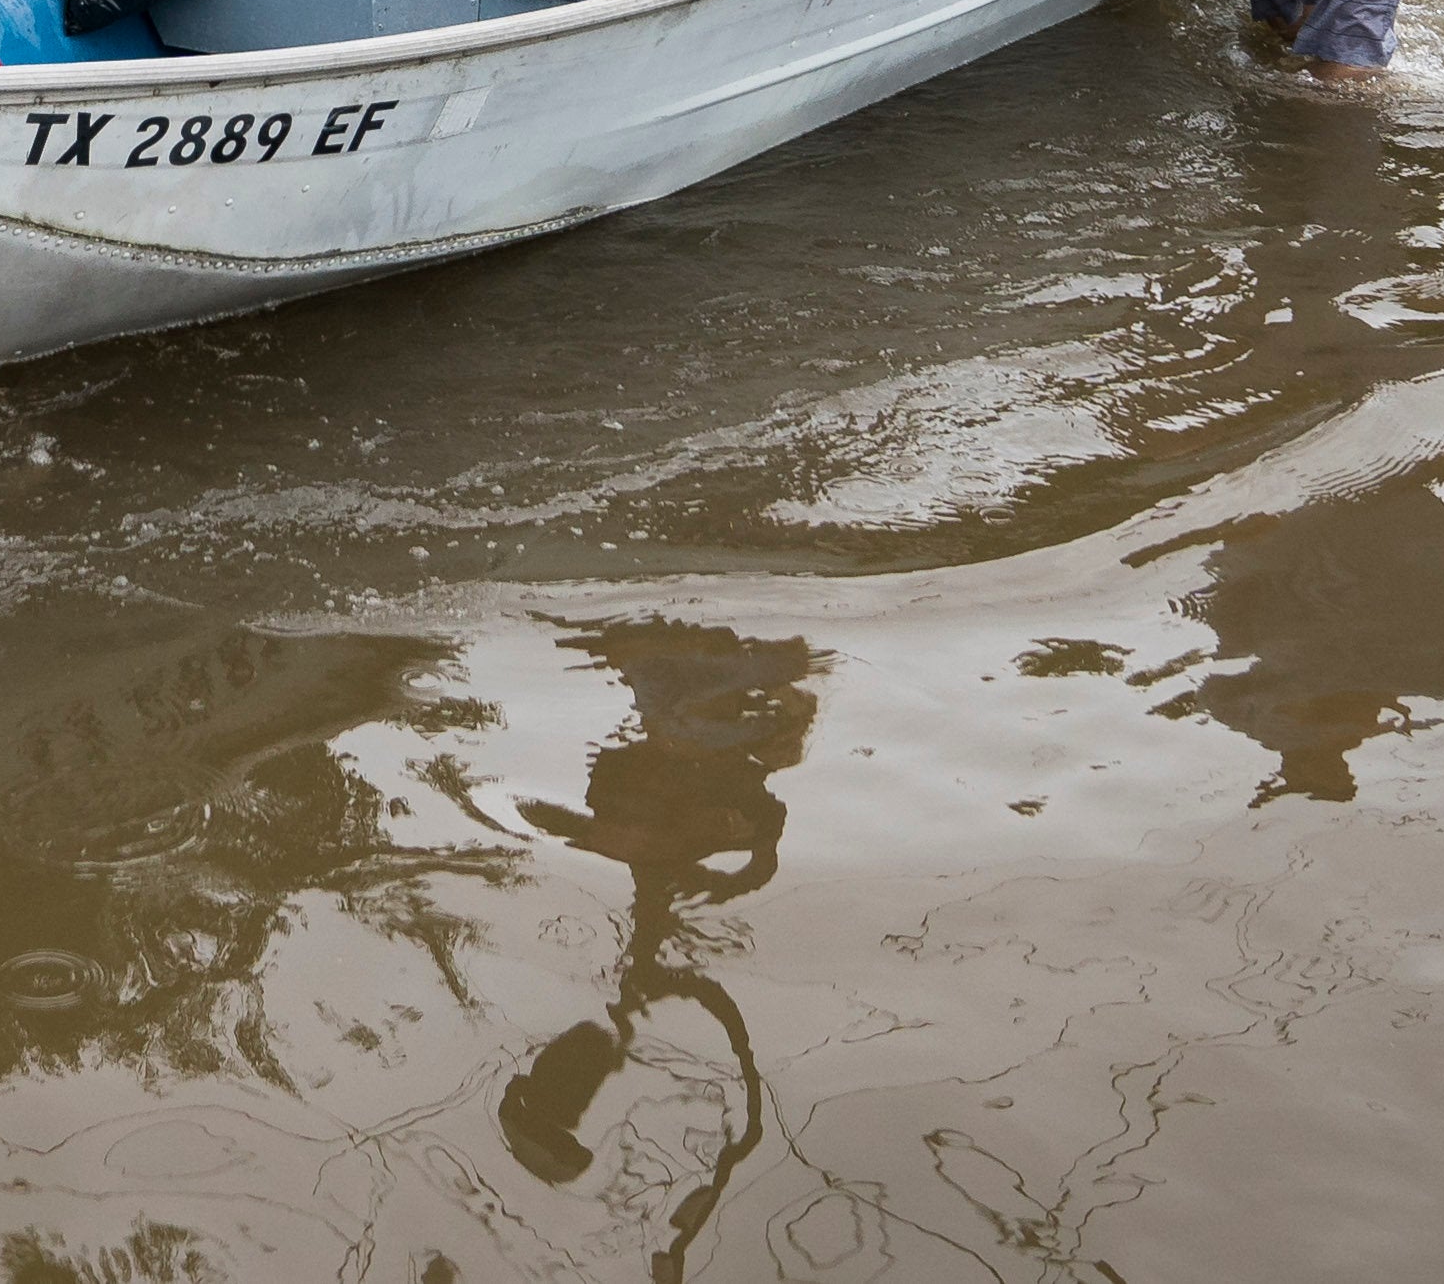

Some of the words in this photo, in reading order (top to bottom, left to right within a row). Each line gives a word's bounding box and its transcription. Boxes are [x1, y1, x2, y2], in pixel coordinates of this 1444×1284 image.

[24, 111, 116, 167] TX
[125, 112, 294, 170] 2889
[311, 99, 400, 156] EF
